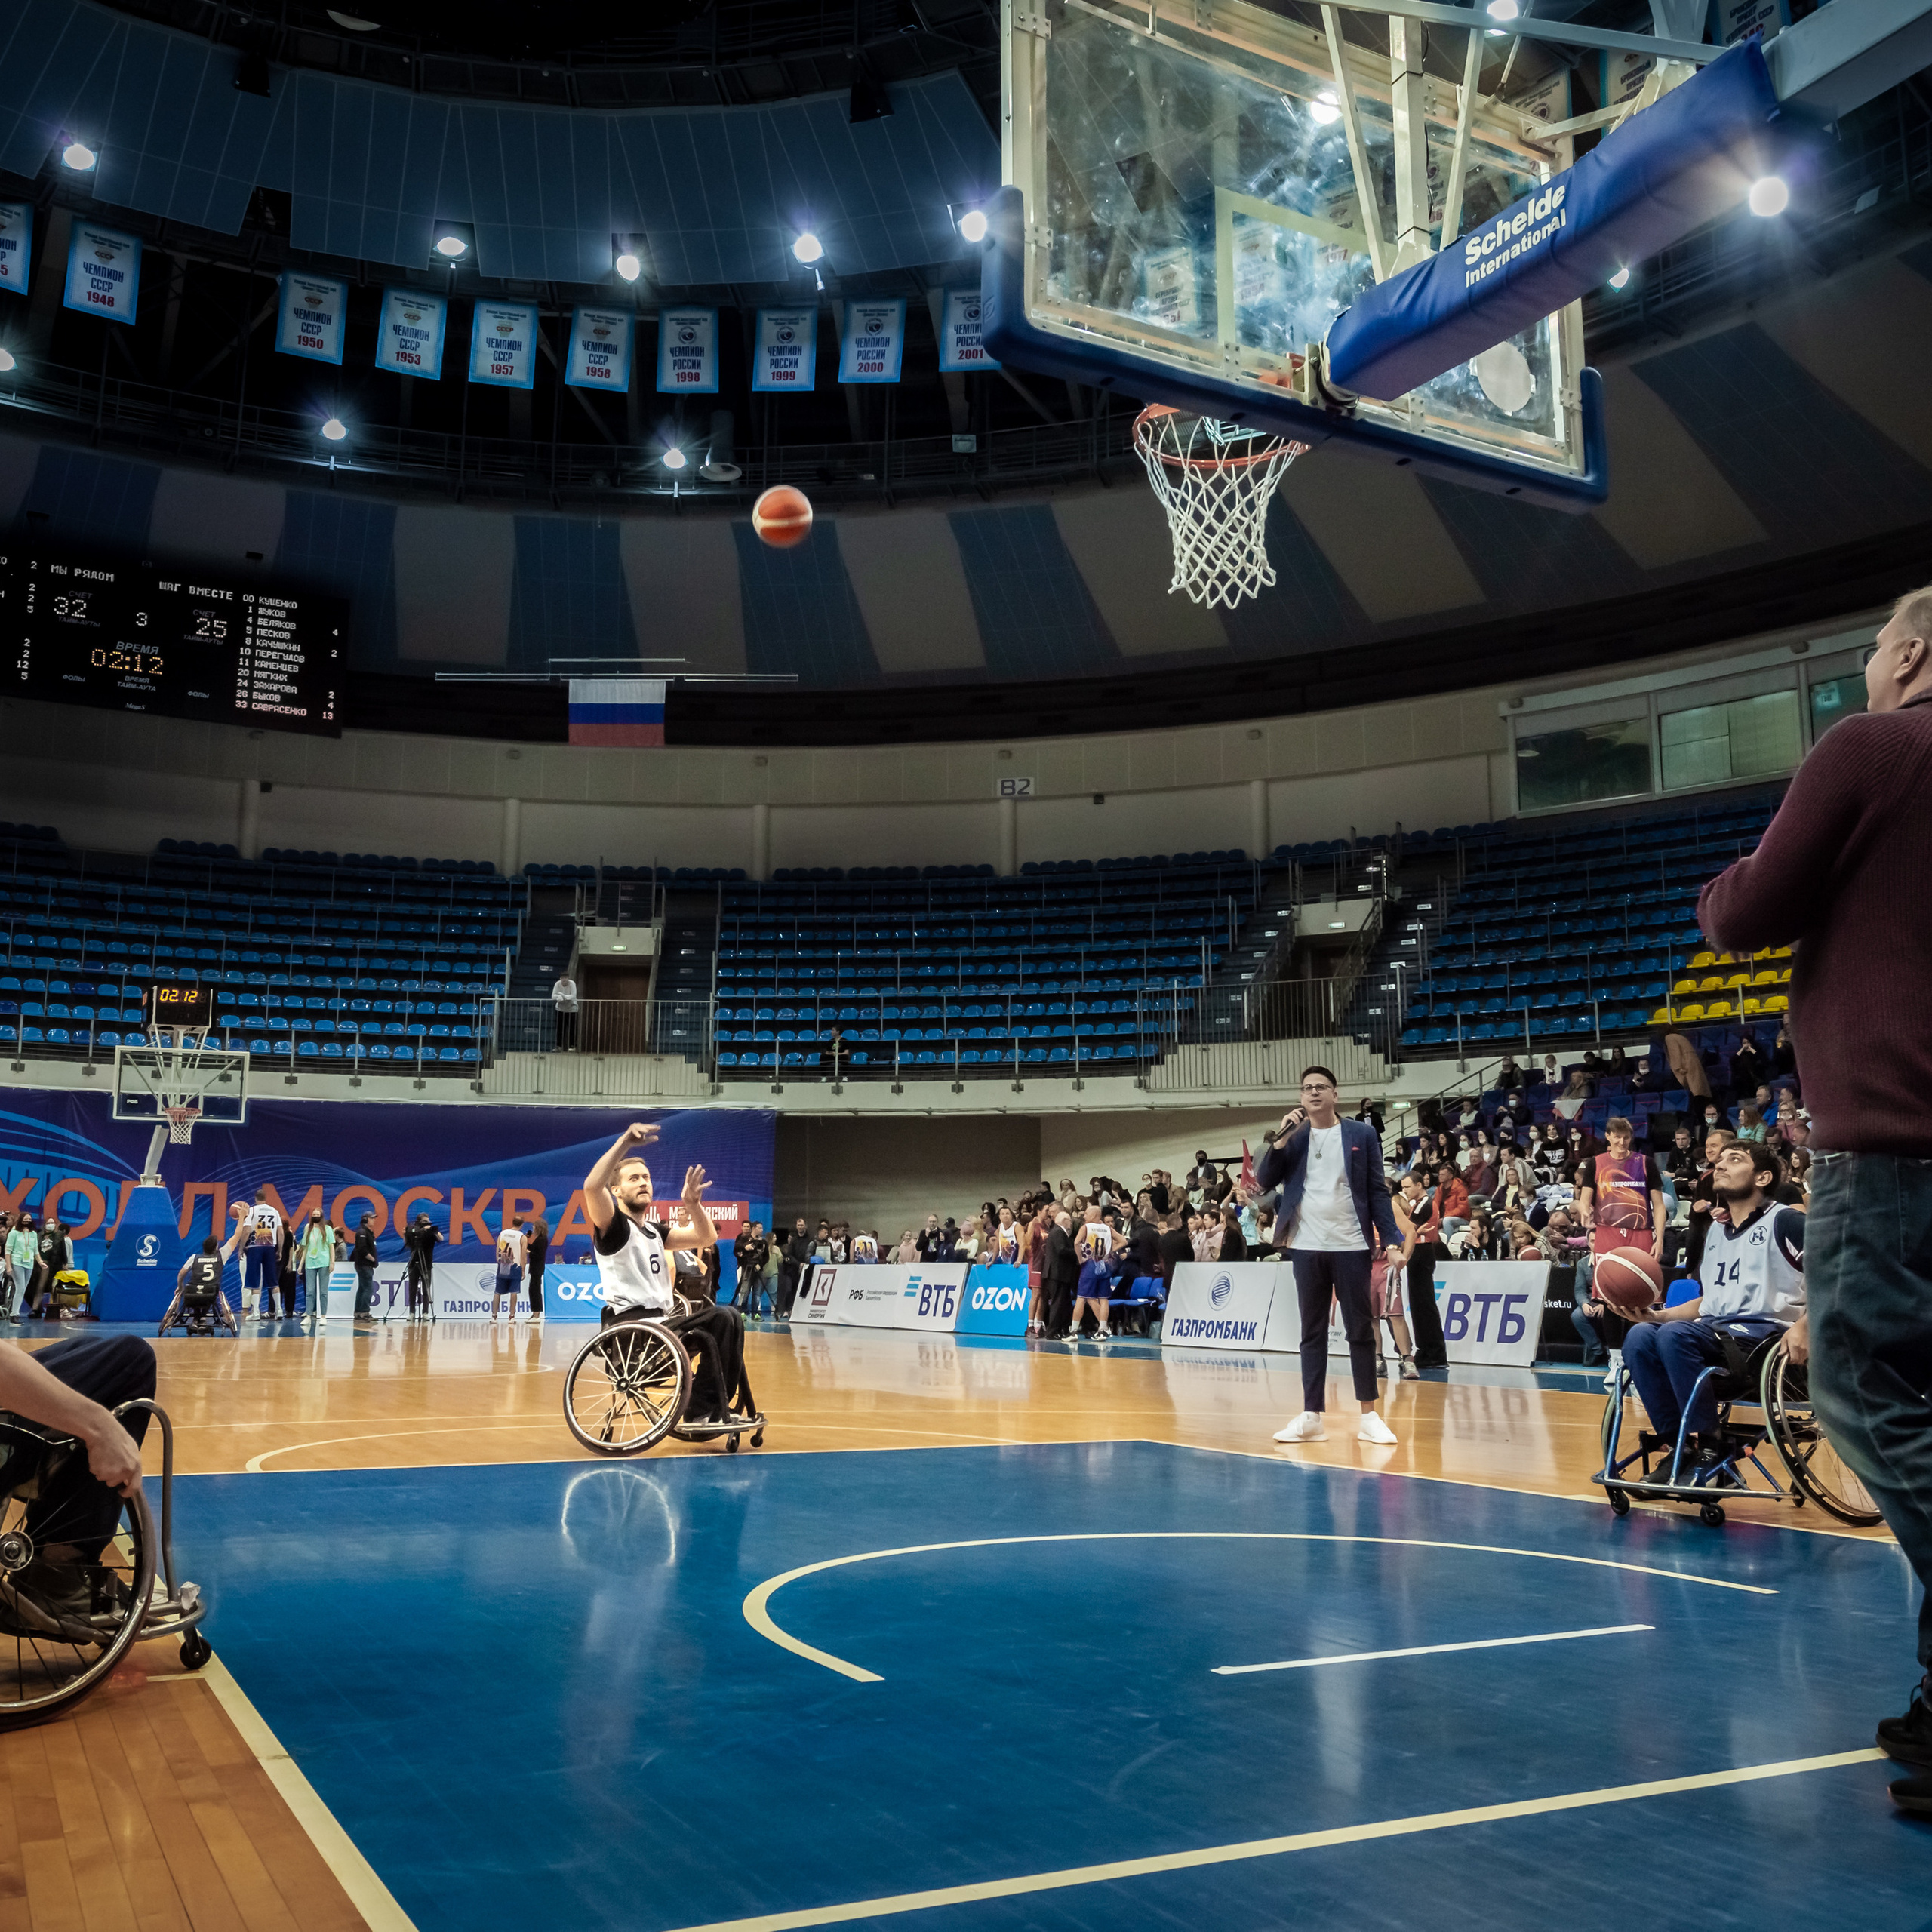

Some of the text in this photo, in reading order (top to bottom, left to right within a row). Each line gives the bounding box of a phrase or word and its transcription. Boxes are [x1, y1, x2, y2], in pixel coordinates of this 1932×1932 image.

[1465, 186, 1565, 266] Schelde
[1466, 208, 1566, 288] International
[83, 262, 124, 283] ЧЕМПИОН
[91, 278, 113, 293] СССР
[87, 291, 115, 308] 1948
[294, 307, 332, 325] ЧЕМПИОН
[301, 321, 322, 336] СССР
[392, 324, 430, 341] ЧЕМПИОН
[954, 323, 982, 334] ЧЕМПИ
[297, 334, 324, 349] 1950
[399, 338, 420, 352] СССР
[486, 337, 522, 352] ЧЕМПИОН
[582, 340, 618, 355] ЧЕМПИОН
[855, 337, 890, 348] ЧЕМПИОН
[493, 350, 513, 363] СССР
[670, 346, 704, 357] ЧЕМПИОН
[768, 345, 802, 356] ЧЕМПИОН
[857, 349, 886, 361] РОССИИ
[958, 349, 983, 360] 2001
[395, 351, 421, 365] 1953
[589, 353, 608, 365] СССР
[672, 358, 701, 370] РОССИИ
[770, 358, 798, 369] РОССИИ
[490, 363, 515, 376] 1957
[586, 365, 611, 379] 1958
[857, 361, 884, 373] 2000
[675, 371, 700, 383] 1998
[771, 371, 796, 381] 1999
[51, 564, 115, 583] МЫ РЯДОМ
[29, 583, 36, 592] 2
[159, 580, 233, 601] ШАГ ВМЕСТЕ
[69, 590, 93, 599] СЧЕТ
[243, 594, 254, 603] 00
[27, 605, 34, 614] 5
[54, 596, 87, 618] 32
[192, 608, 216, 618] СЧЕТ
[248, 605, 253, 614] 1
[136, 612, 148, 626] 3
[196, 617, 227, 638] 25
[245, 626, 291, 639] 5 ПЕСКОВ
[247, 616, 253, 624] 4
[332, 629, 338, 637] 4
[23, 638, 30, 647] 2
[245, 637, 251, 645] 8
[23, 650, 29, 658] 2
[115, 641, 160, 655] ВРЕМЯ
[239, 647, 251, 656] 10
[17, 660, 29, 669] 12
[91, 648, 163, 675] 02:12
[238, 657, 249, 666] 11
[21, 671, 29, 680] 5
[63, 674, 86, 682] ФОЛЫ
[237, 668, 250, 677] 20
[125, 675, 150, 684] ВРЕМЯ
[187, 691, 210, 699] ФОЛЫ
[236, 678, 248, 688] 24
[328, 691, 334, 699] 2
[236, 689, 248, 698] 26
[235, 700, 248, 709] 33
[322, 711, 334, 720] 13
[649, 1254, 660, 1274] 6
[202, 1263, 216, 1281] 5
[1714, 1257, 1740, 1287] 14
[557, 1281, 605, 1302] OZO
[848, 1289, 865, 1300] РФБ
[918, 1284, 957, 1318] ВТБ
[971, 1286, 1027, 1311] OZON
[1444, 1293, 1529, 1343] ВТБ
[1171, 1318, 1257, 1340] ГАЗПРОМБАНК
